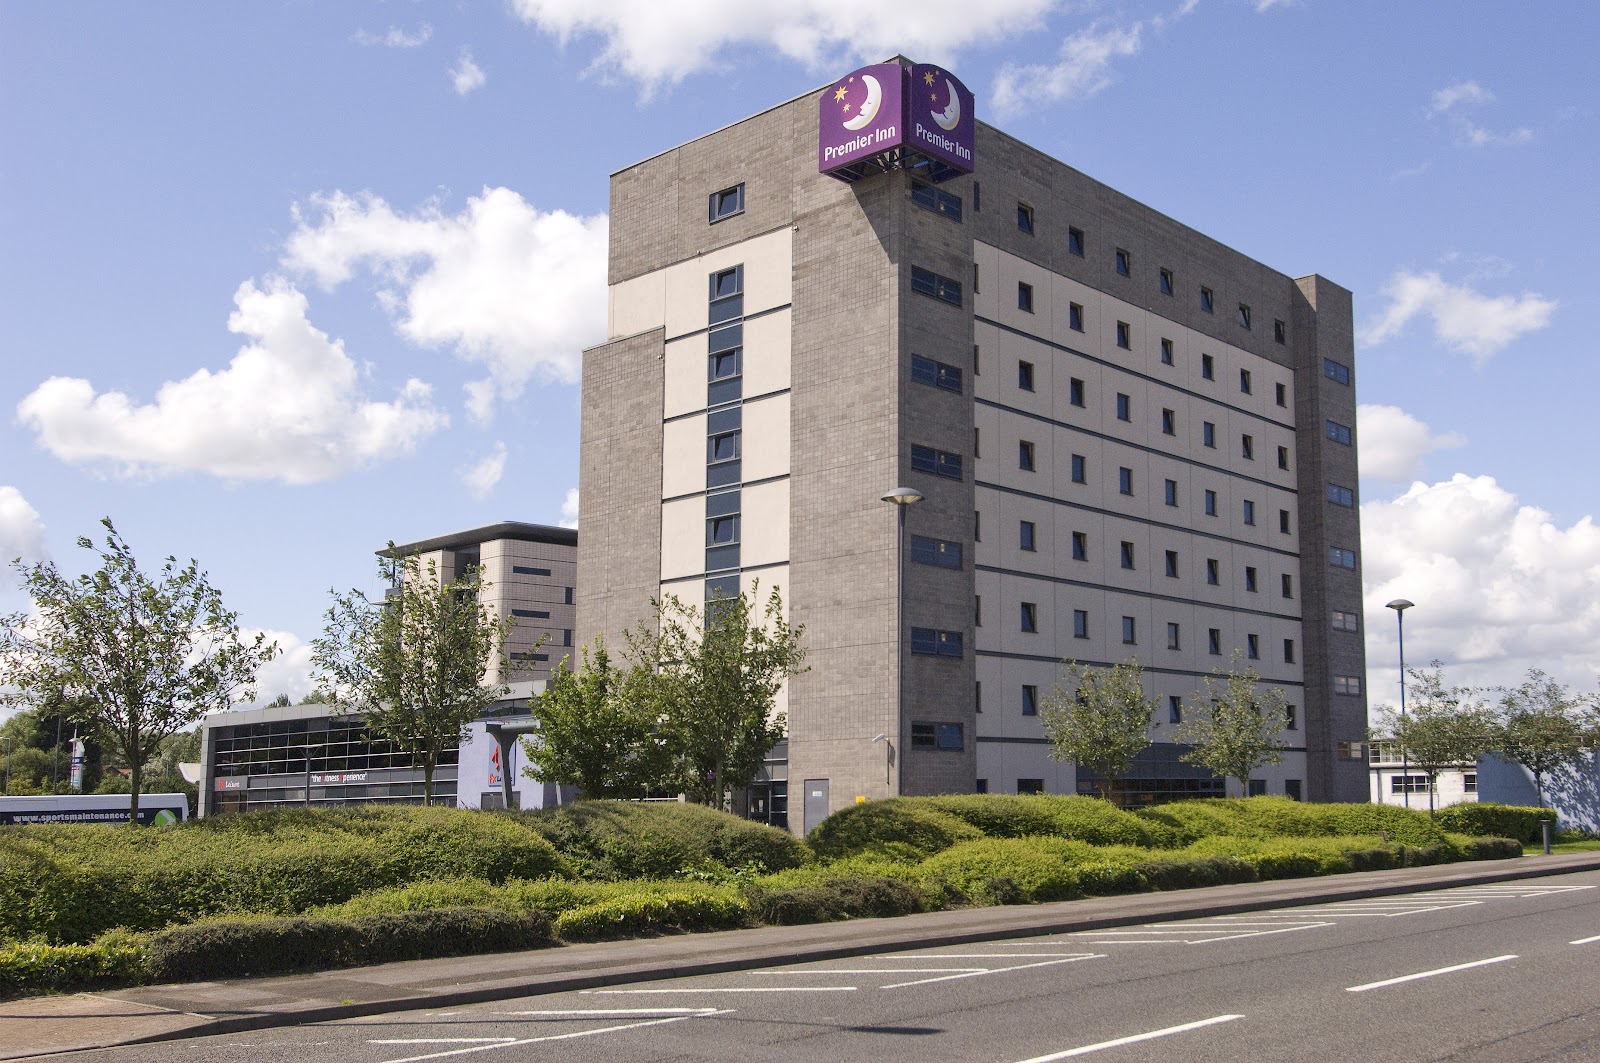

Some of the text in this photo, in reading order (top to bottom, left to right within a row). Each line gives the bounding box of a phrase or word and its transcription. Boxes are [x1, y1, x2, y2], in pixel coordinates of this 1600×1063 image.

[824, 126, 896, 161] Premier Inn
[916, 123, 971, 160] Premier Inn
[13, 811, 145, 823] www.sportsmaintenance.cm
